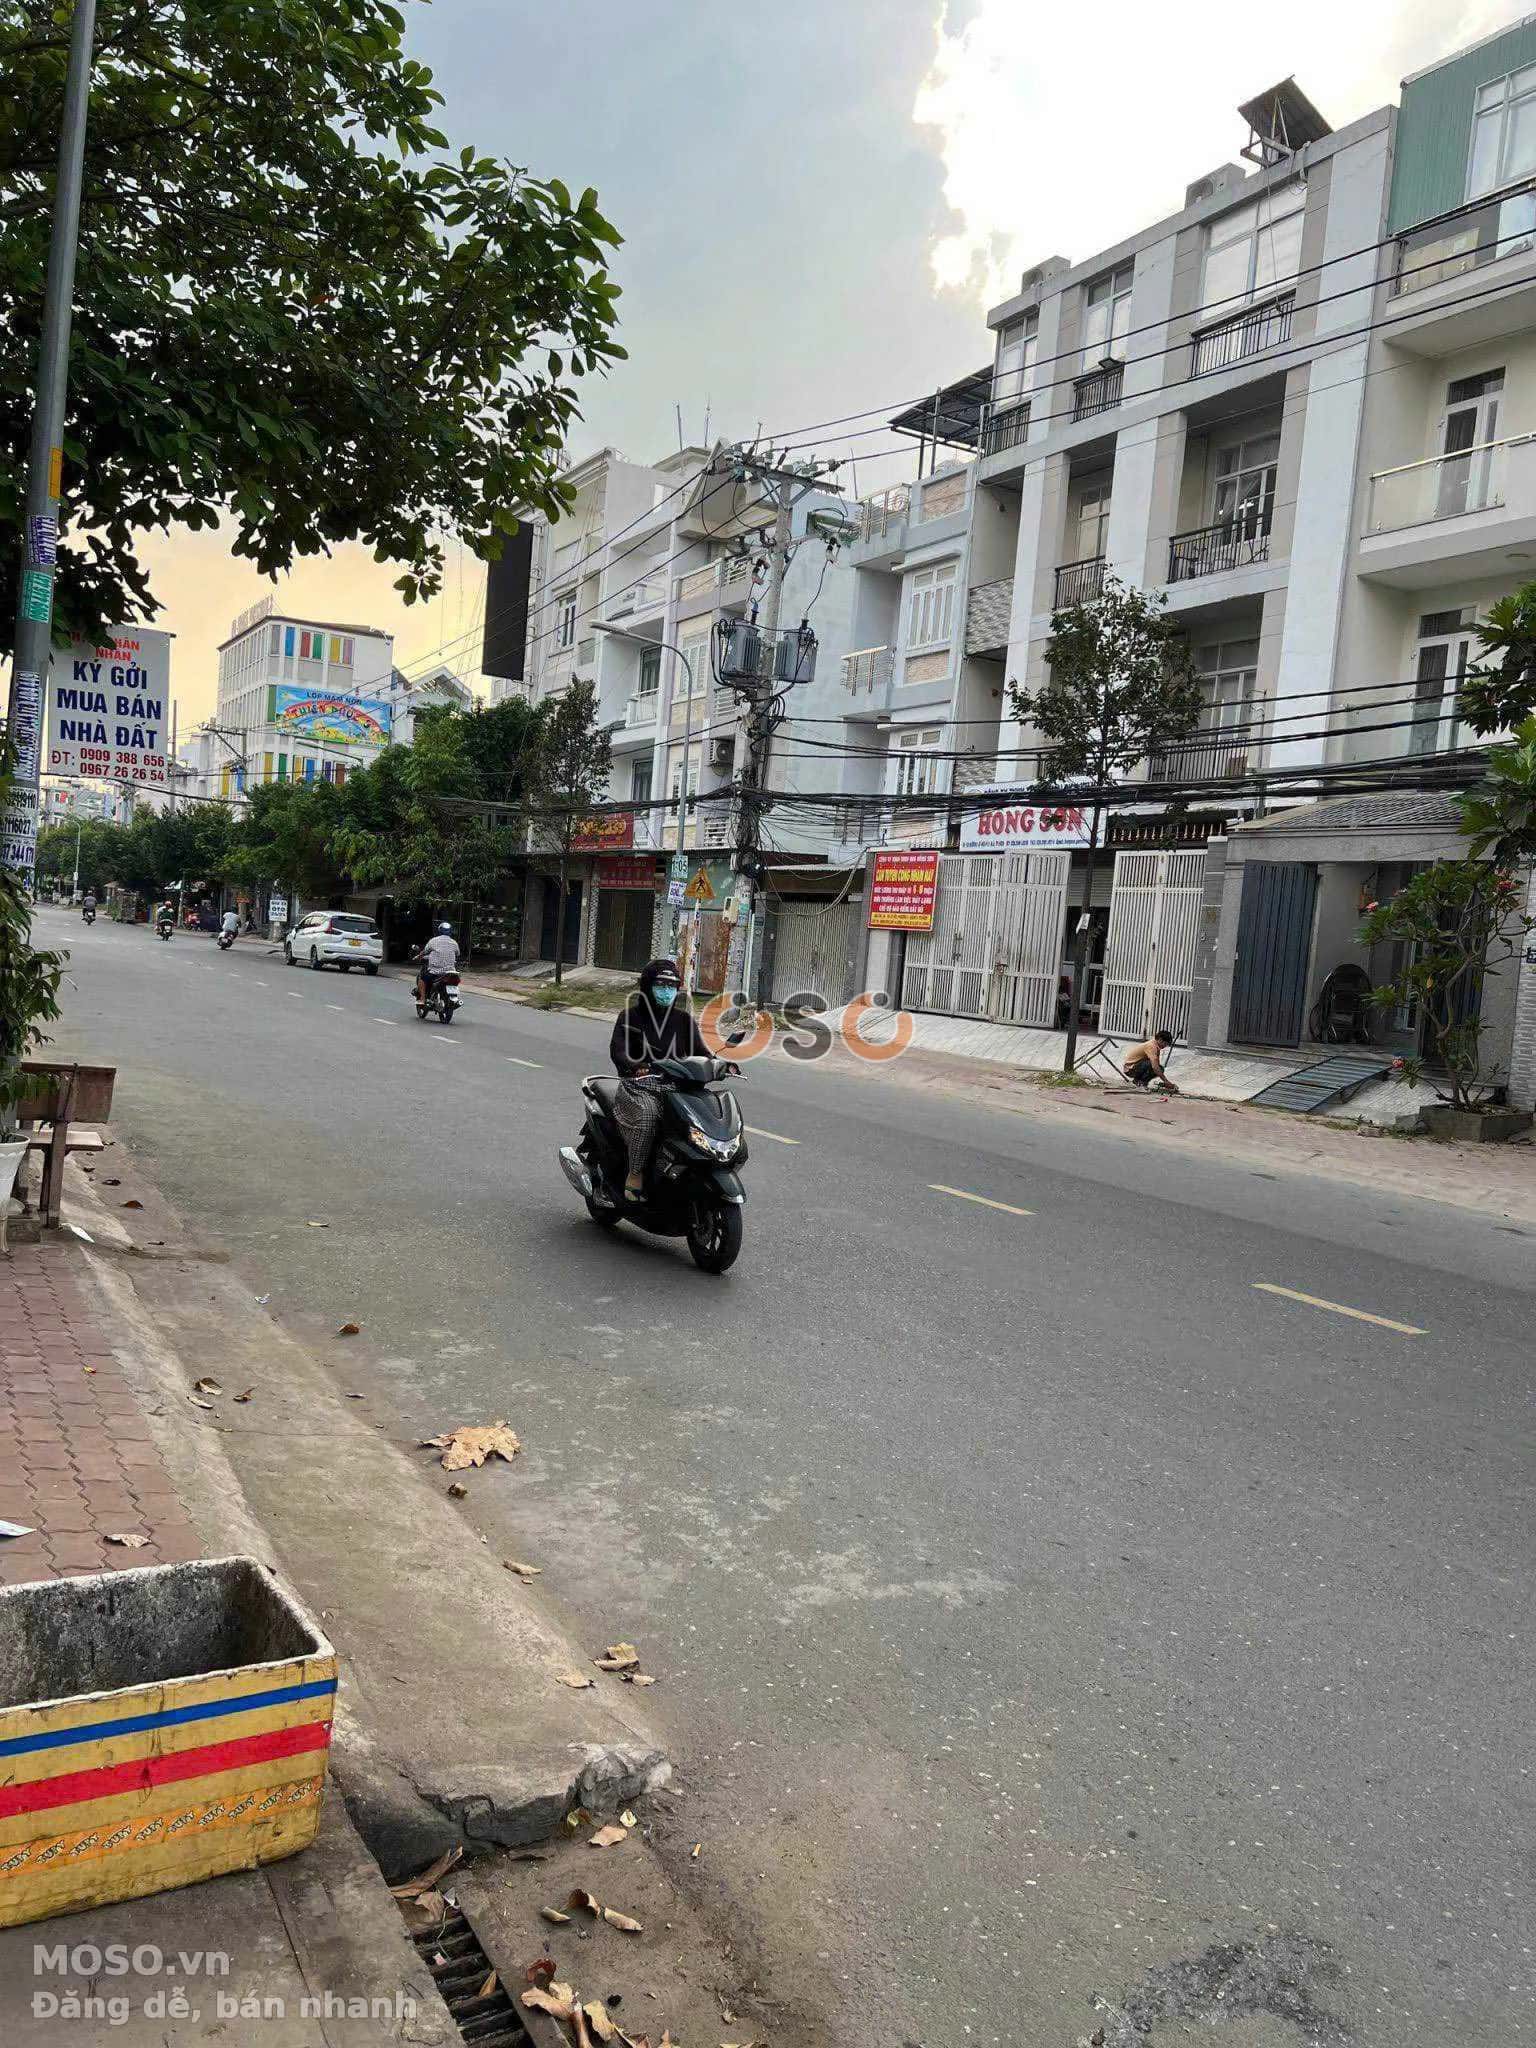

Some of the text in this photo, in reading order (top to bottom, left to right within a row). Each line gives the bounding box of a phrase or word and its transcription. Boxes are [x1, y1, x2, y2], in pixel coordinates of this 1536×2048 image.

[73, 659, 148, 690] KÝ GỞI
[57, 688, 162, 720] MUA BÁN
[60, 719, 158, 750] NHÀ ĐẤT
[51, 748, 165, 767] ĐT: 0909 388 656
[79, 762, 165, 782] 0967 26 26 54
